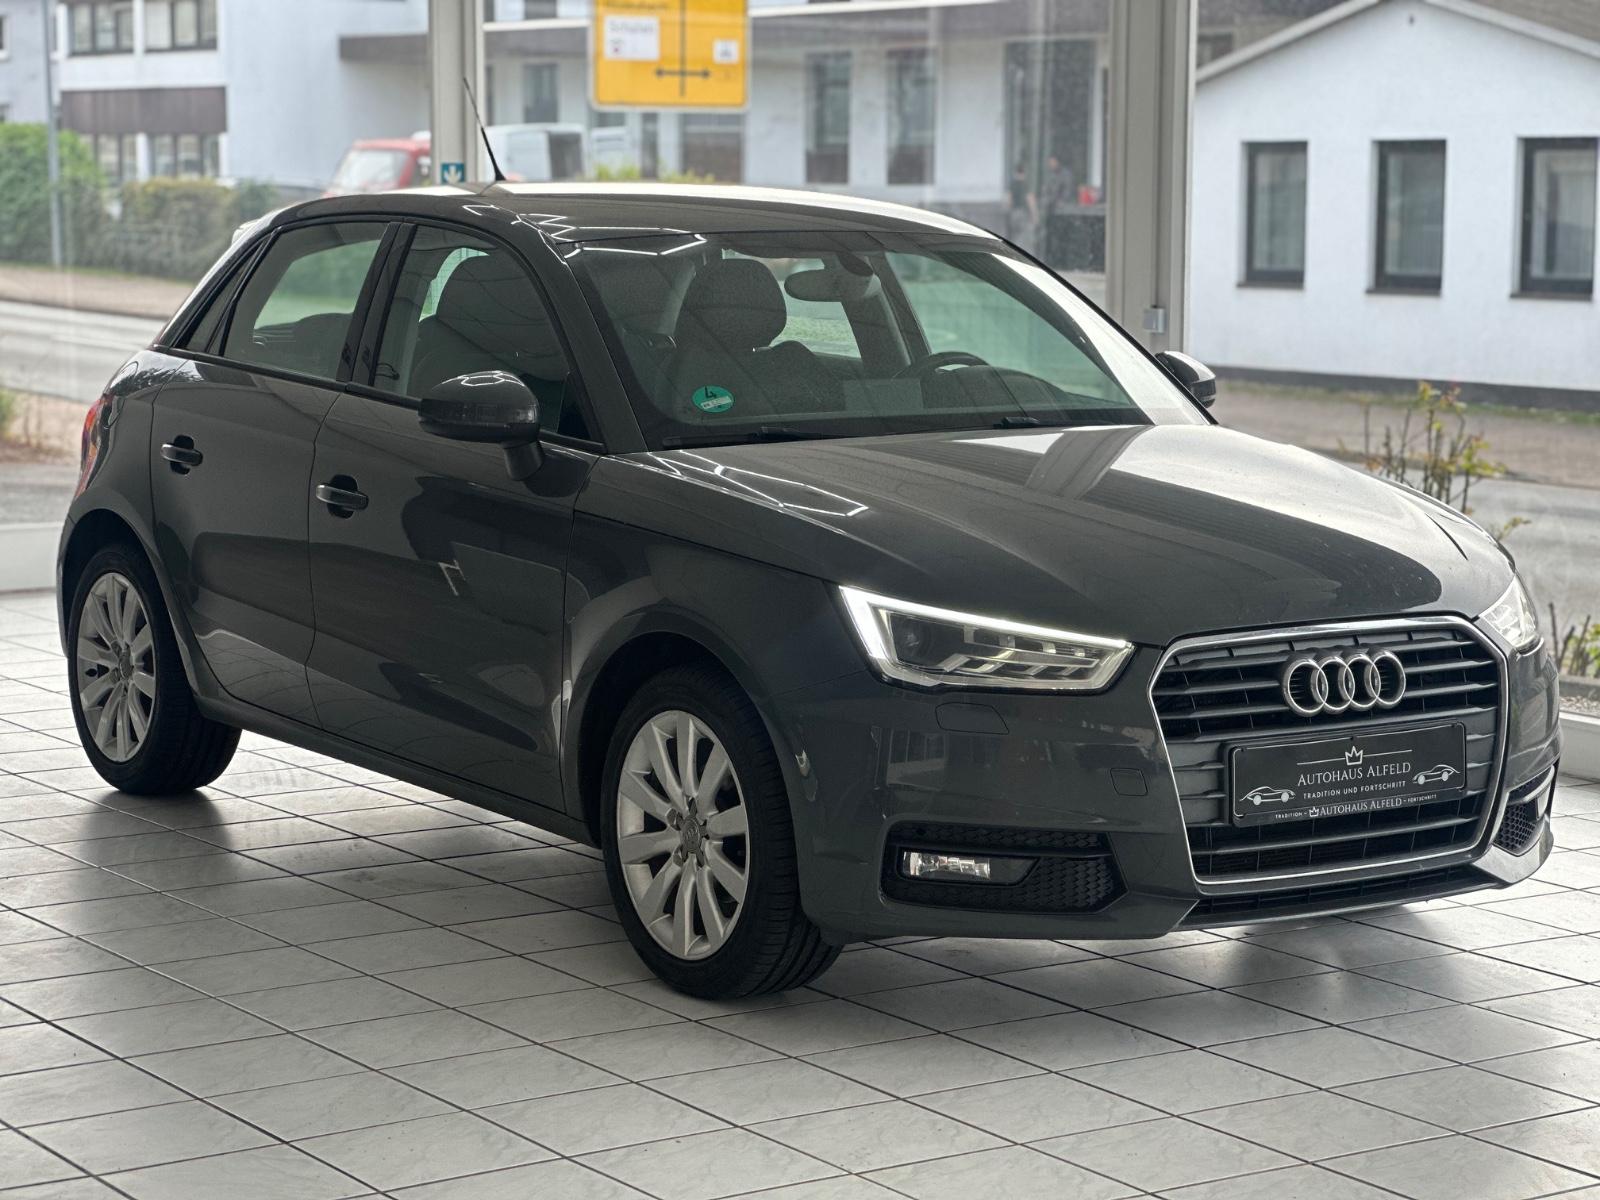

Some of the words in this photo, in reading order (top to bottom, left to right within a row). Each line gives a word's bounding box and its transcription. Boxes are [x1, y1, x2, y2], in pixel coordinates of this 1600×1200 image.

[705, 386, 717, 399] 4
[1297, 767, 1363, 787] AUTOHAUS
[1367, 762, 1411, 778] ALFELD
[1303, 788, 1341, 800] TRADITION
[1343, 787, 1358, 795] UND
[1361, 780, 1406, 793] FORTSCHRITT
[1275, 811, 1303, 819] TRADITION
[1320, 801, 1368, 817] AUTOHAUS
[1369, 797, 1402, 810] ALFELD
[1407, 794, 1437, 803] FORTSCHRITT
